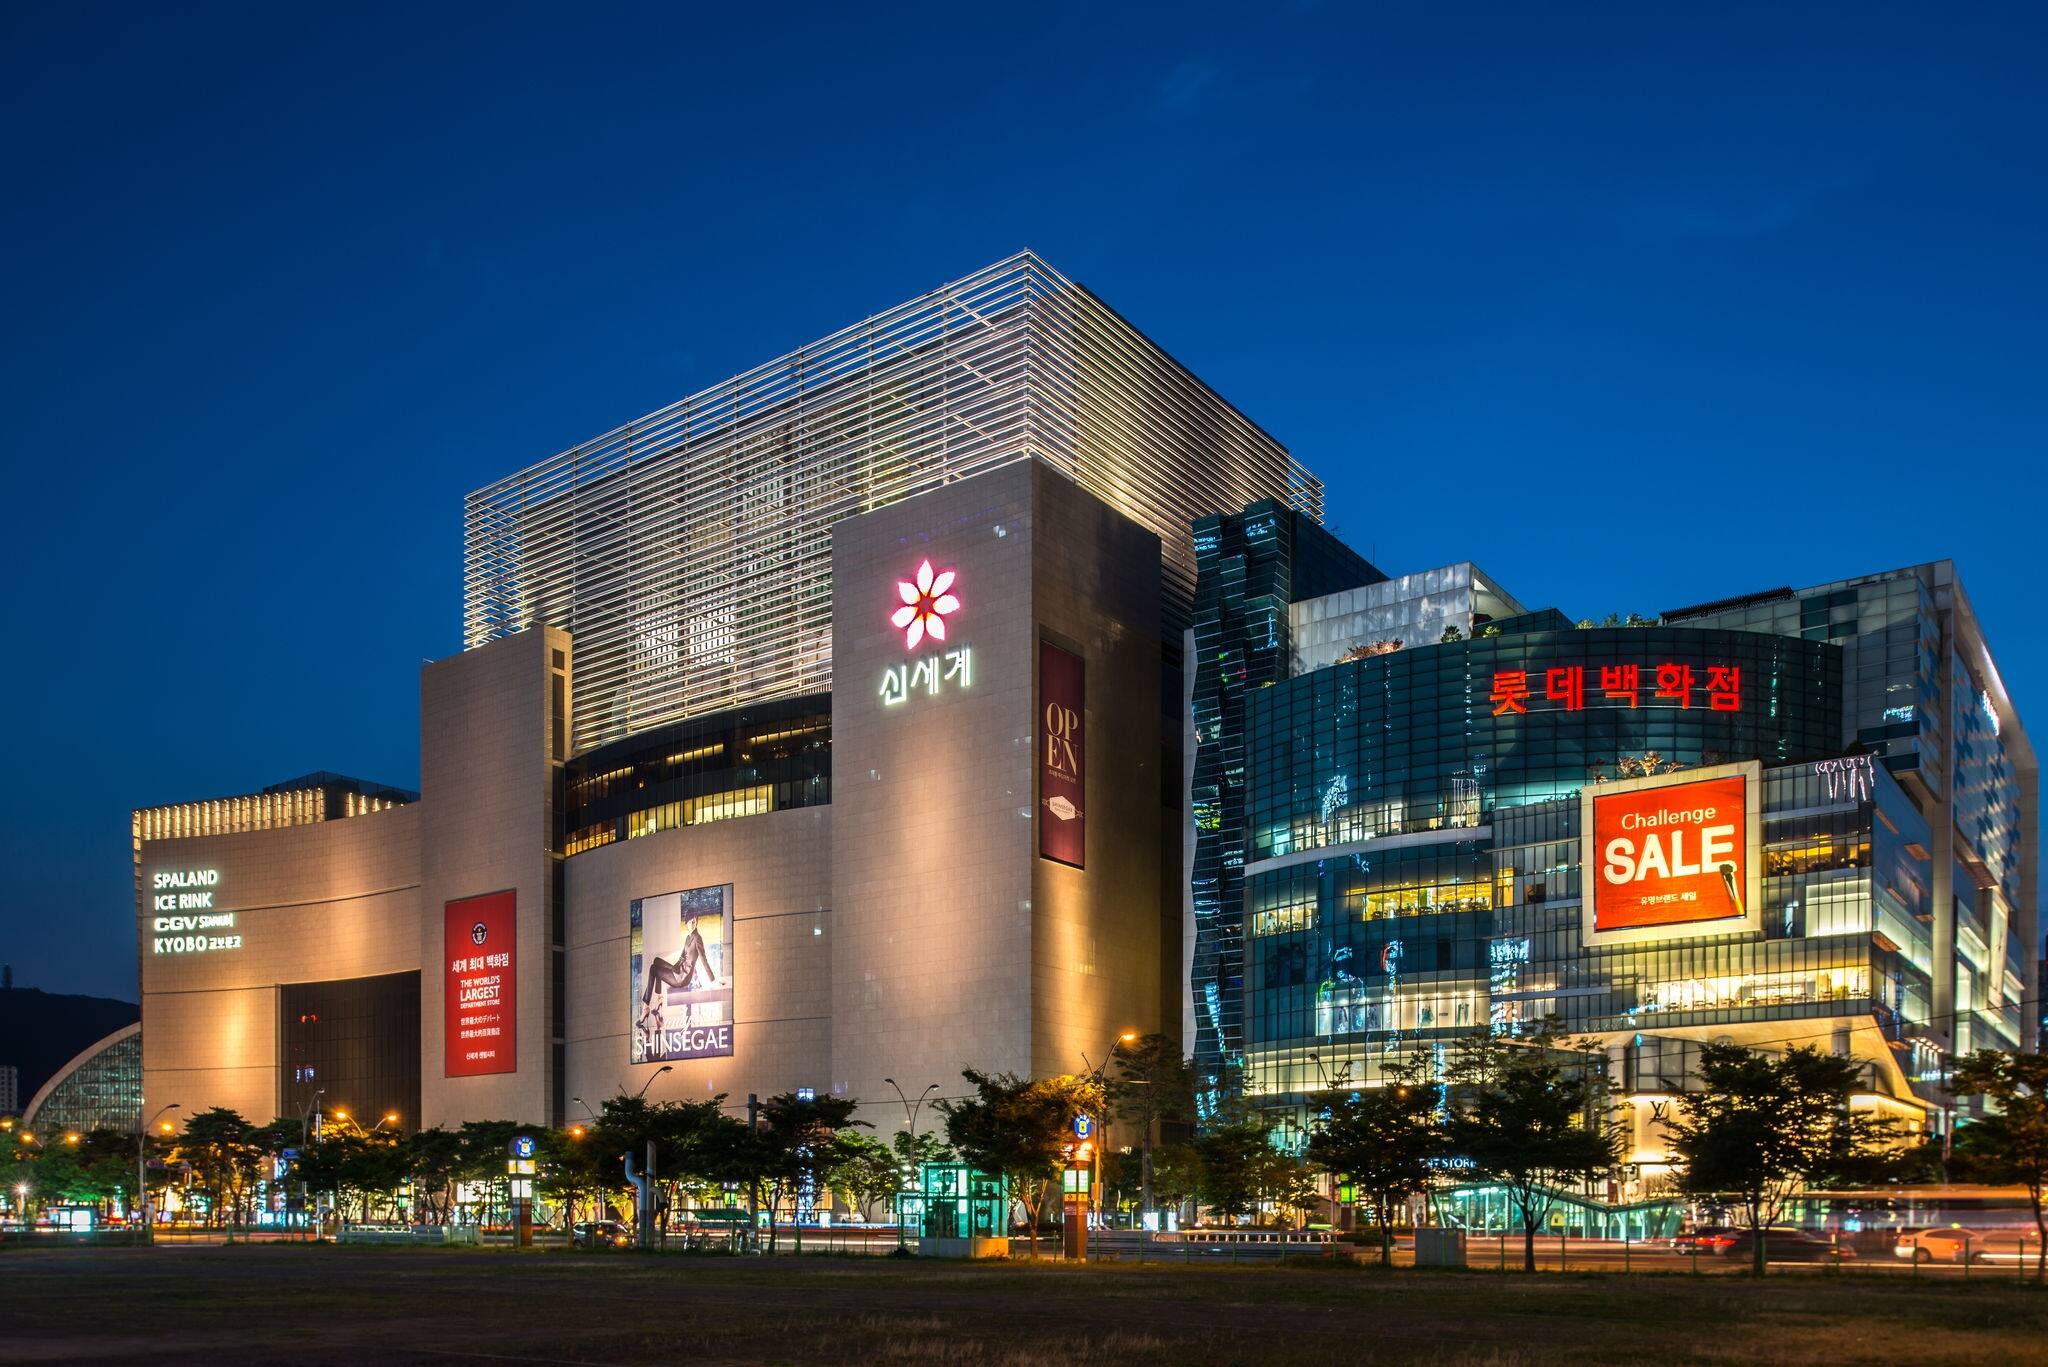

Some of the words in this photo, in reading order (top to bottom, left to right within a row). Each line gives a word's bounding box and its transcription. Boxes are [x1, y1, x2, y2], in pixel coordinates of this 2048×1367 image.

[879, 648, 971, 706] 신세계
[1489, 662, 1742, 717] 롯데백화점
[1621, 806, 1717, 830] Challenge
[1603, 824, 1738, 885] SALE
[153, 869, 218, 889] SPALAND
[154, 894, 177, 910] ICE
[179, 892, 213, 909] RINK
[1680, 891, 1697, 902] 세일
[154, 916, 198, 931] CGV
[154, 935, 207, 954] KYOBO
[452, 959, 468, 973] 세계
[469, 956, 484, 971] 최대
[486, 952, 509, 968] 백화점
[460, 978, 473, 989] THE
[472, 975, 500, 986] WORLD'S
[460, 985, 500, 1002] LARGEST
[634, 1027, 728, 1057] SHINSEGAE
